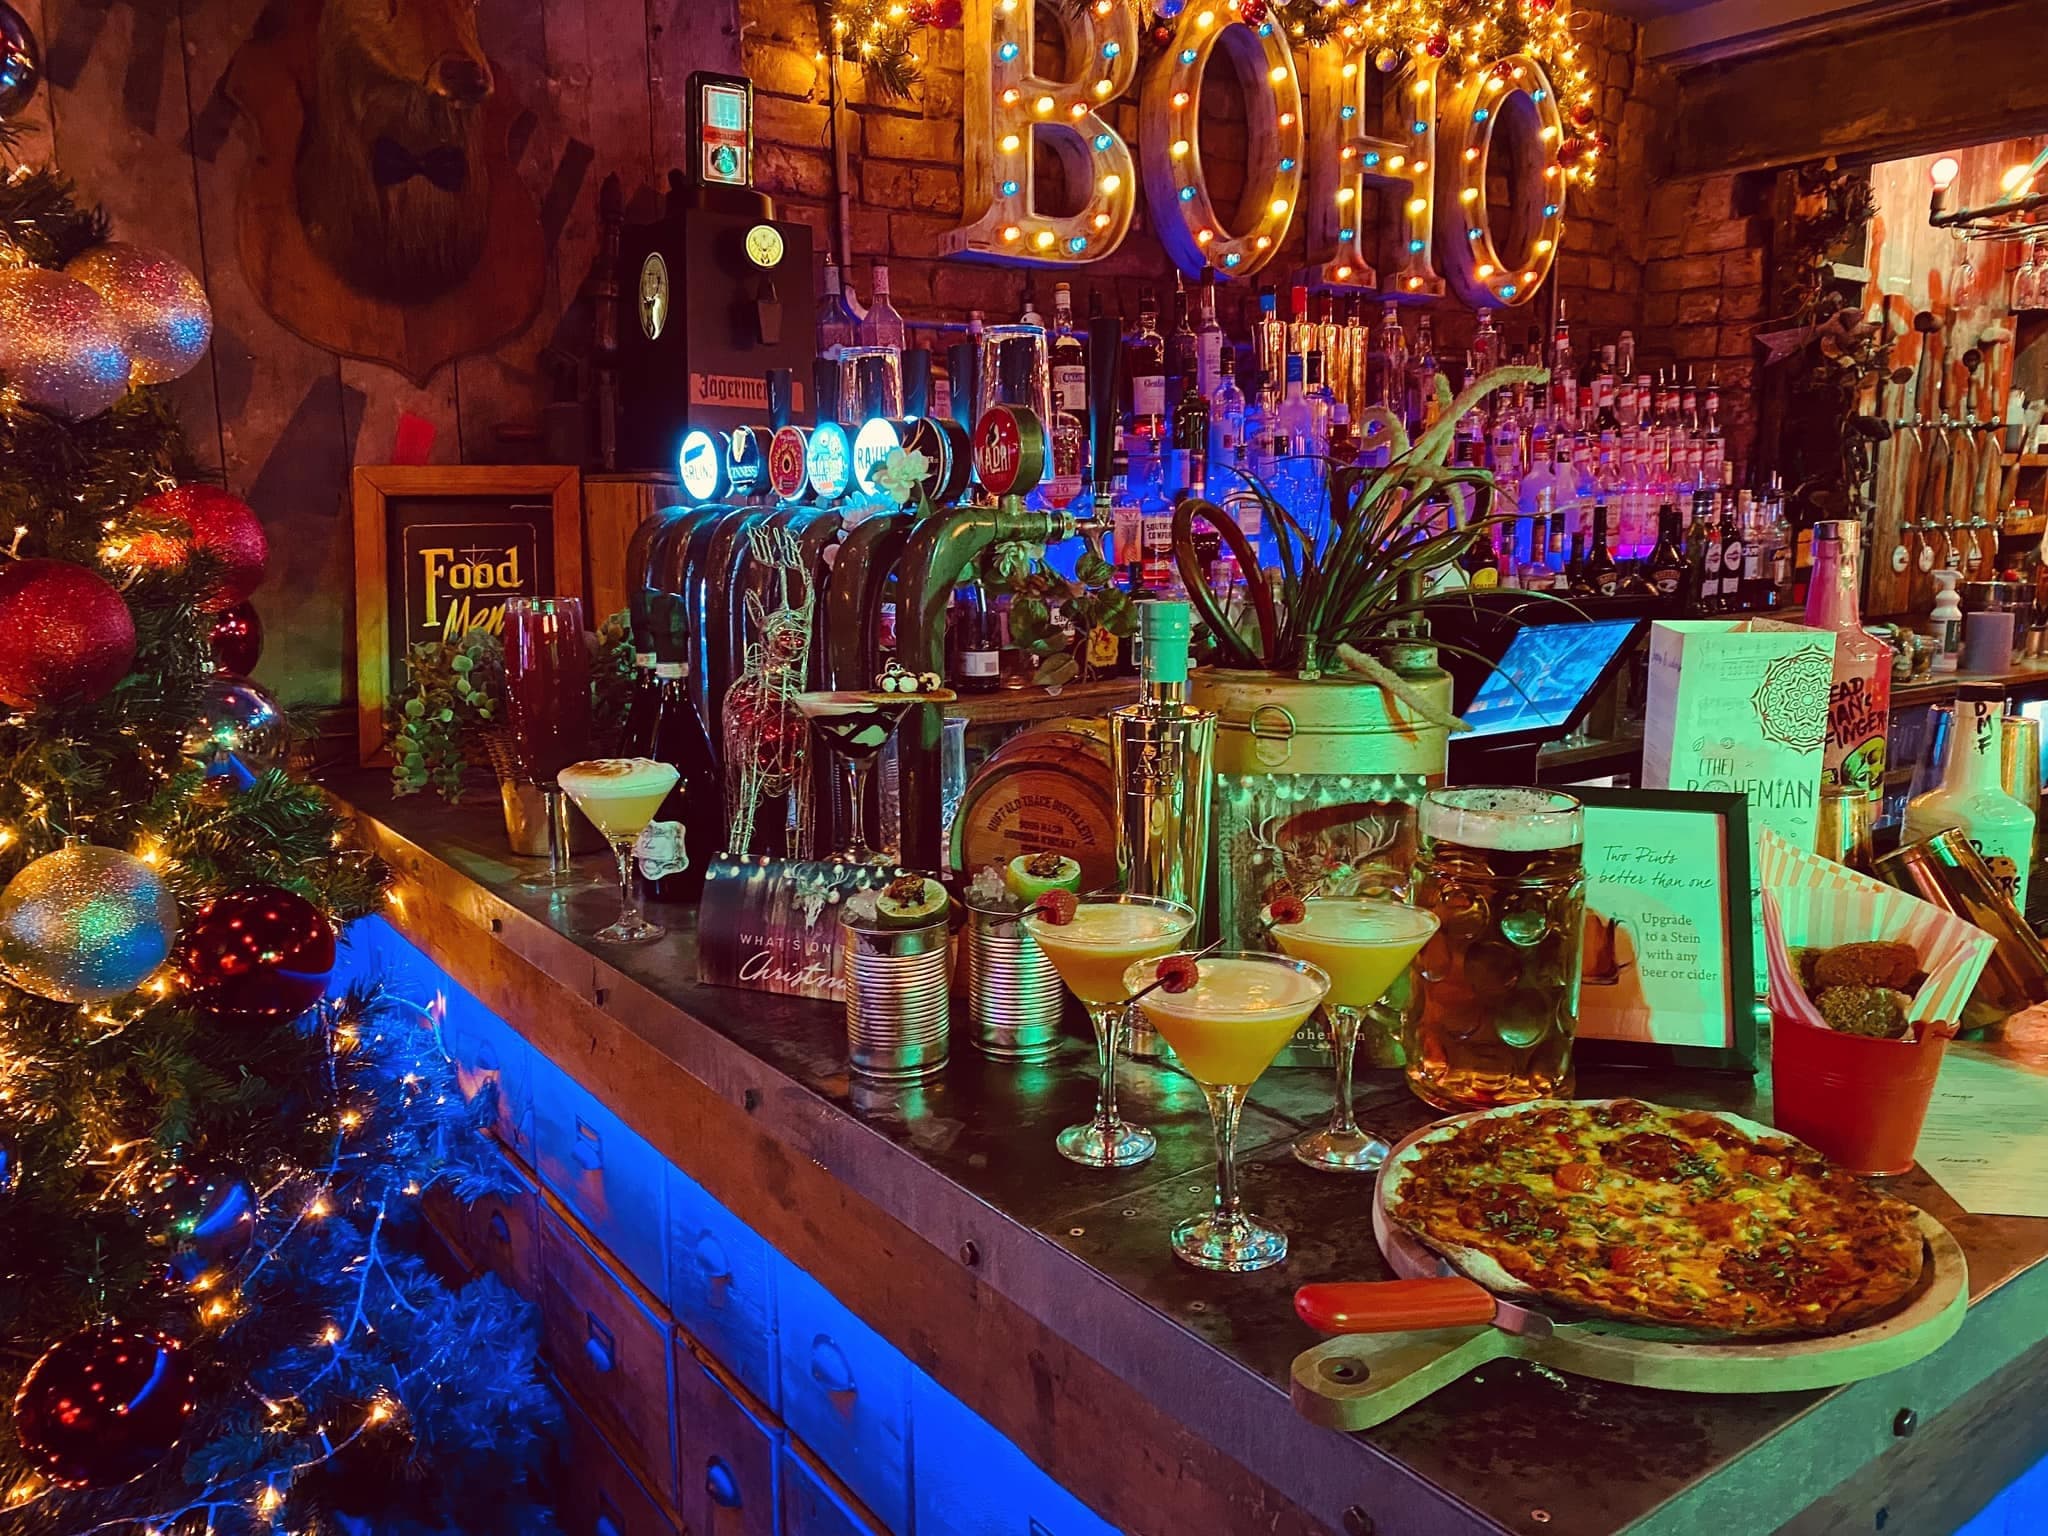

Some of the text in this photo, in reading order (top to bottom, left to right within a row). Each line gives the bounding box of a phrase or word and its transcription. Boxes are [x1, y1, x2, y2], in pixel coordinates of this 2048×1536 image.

[938, 0, 1566, 308] BOHO
[419, 545, 524, 627] Food
[442, 596, 507, 644] Men
[1829, 676, 1864, 705] EAD
[1603, 845, 1679, 865] Two Pints
[1599, 868, 1647, 885] better
[1651, 871, 1686, 889] than
[1689, 877, 1714, 889] one
[1641, 912, 1693, 931] Upgrade
[740, 934, 801, 950] WHAT'S
[811, 943, 831, 953] ON
[1645, 930, 1701, 944] to a Stein
[1646, 948, 1698, 966] with any
[738, 951, 847, 988] Christm
[1641, 965, 1717, 982] beer or cider
